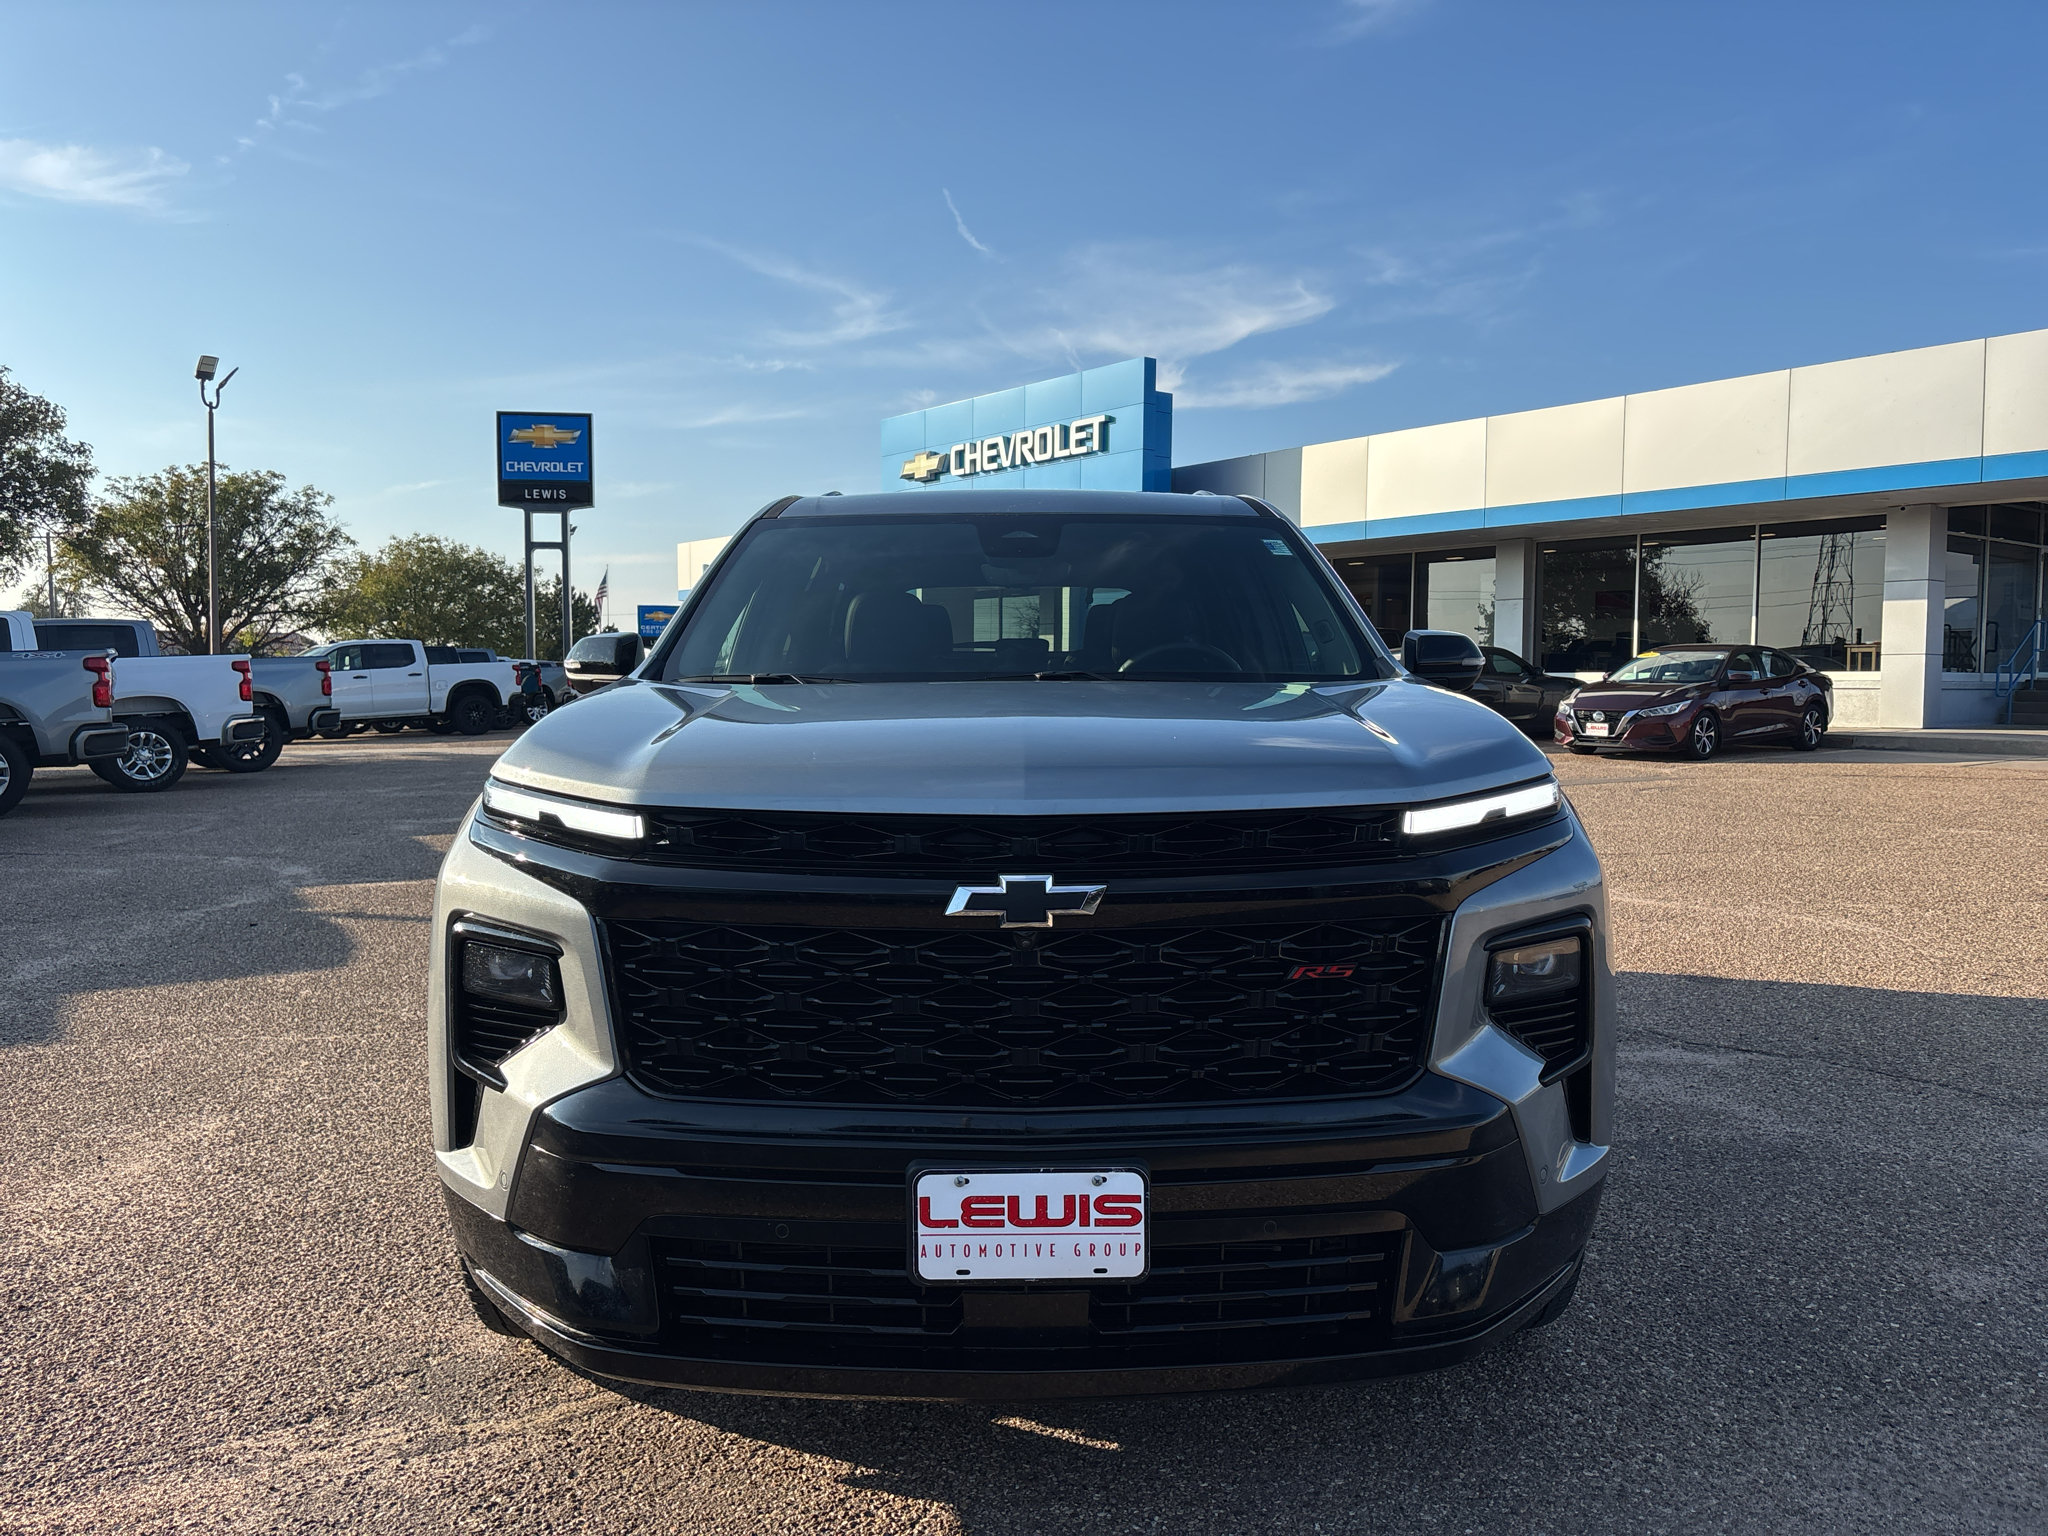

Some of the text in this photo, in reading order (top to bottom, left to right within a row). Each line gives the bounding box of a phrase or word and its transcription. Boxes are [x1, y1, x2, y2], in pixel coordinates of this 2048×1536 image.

[950, 414, 1109, 476] CHEVROLET
[506, 461, 584, 473] CHEVROLET
[525, 489, 567, 500] LEWIS
[1288, 964, 1357, 979] RS
[919, 1194, 1143, 1228] LEWIS
[920, 1242, 1142, 1258] AUTOMOTIVE GROUP
